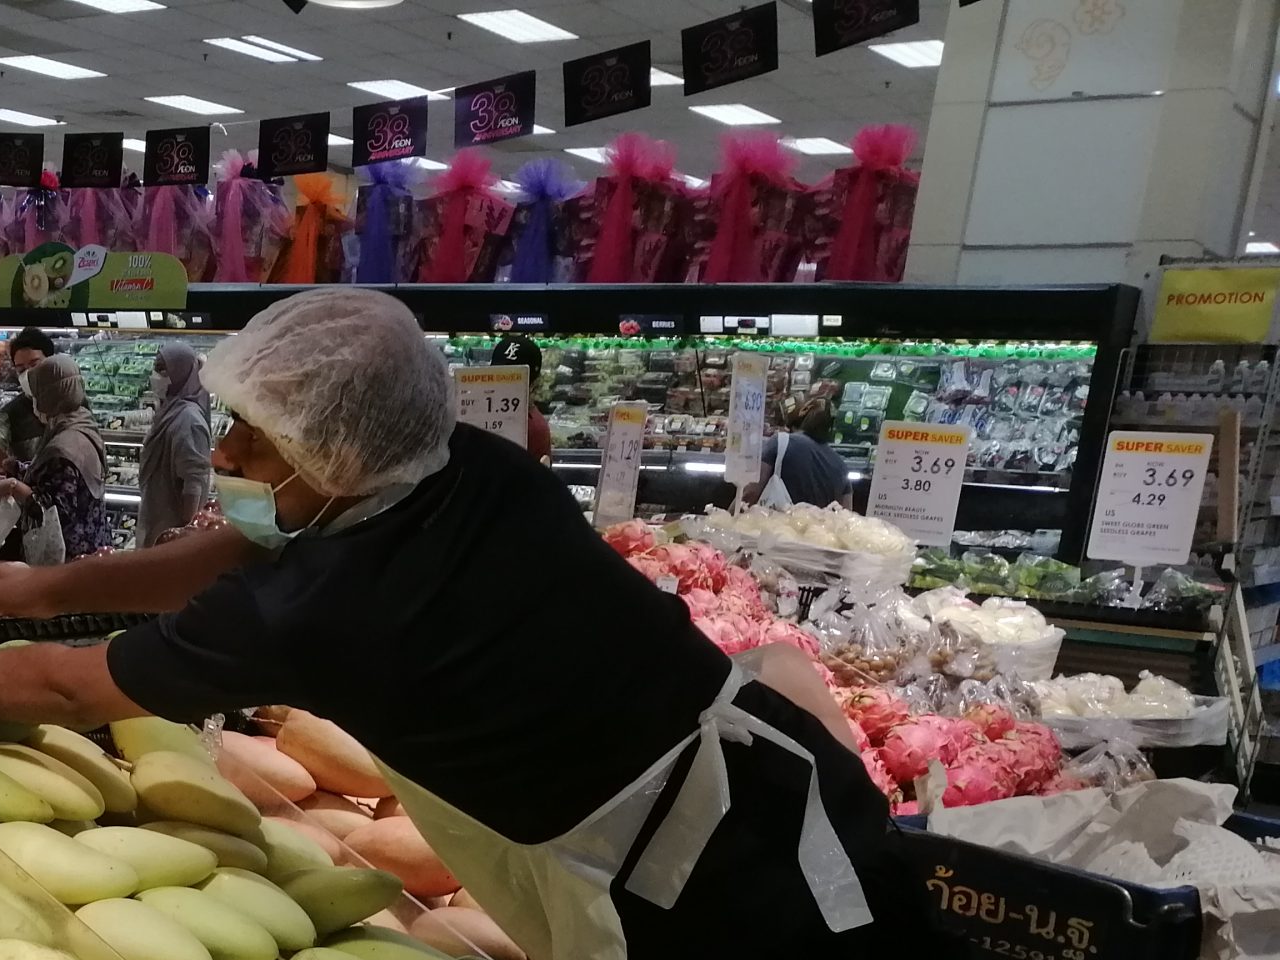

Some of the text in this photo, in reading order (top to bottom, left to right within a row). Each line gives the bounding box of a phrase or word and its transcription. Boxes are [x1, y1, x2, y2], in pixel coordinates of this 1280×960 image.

[470, 91, 516, 133] 38
[367, 112, 410, 152] 38
[128, 254, 152, 269] 100%
[1166, 291, 1265, 306] PROMOTION
[517, 317, 544, 325] SEASONAL
[652, 320, 676, 329] BERRIES
[461, 374, 494, 383] SUPER
[486, 397, 520, 413] 1.39
[485, 421, 503, 430] 1.59
[888, 429, 963, 444] SUPER SAVER
[1116, 440, 1204, 454] SUPER SAVER
[911, 455, 956, 475] 3.69
[1142, 467, 1195, 487] 3.69
[901, 478, 931, 492] 3.80
[1132, 492, 1166, 506] 4.29
[1105, 509, 1116, 517] US
